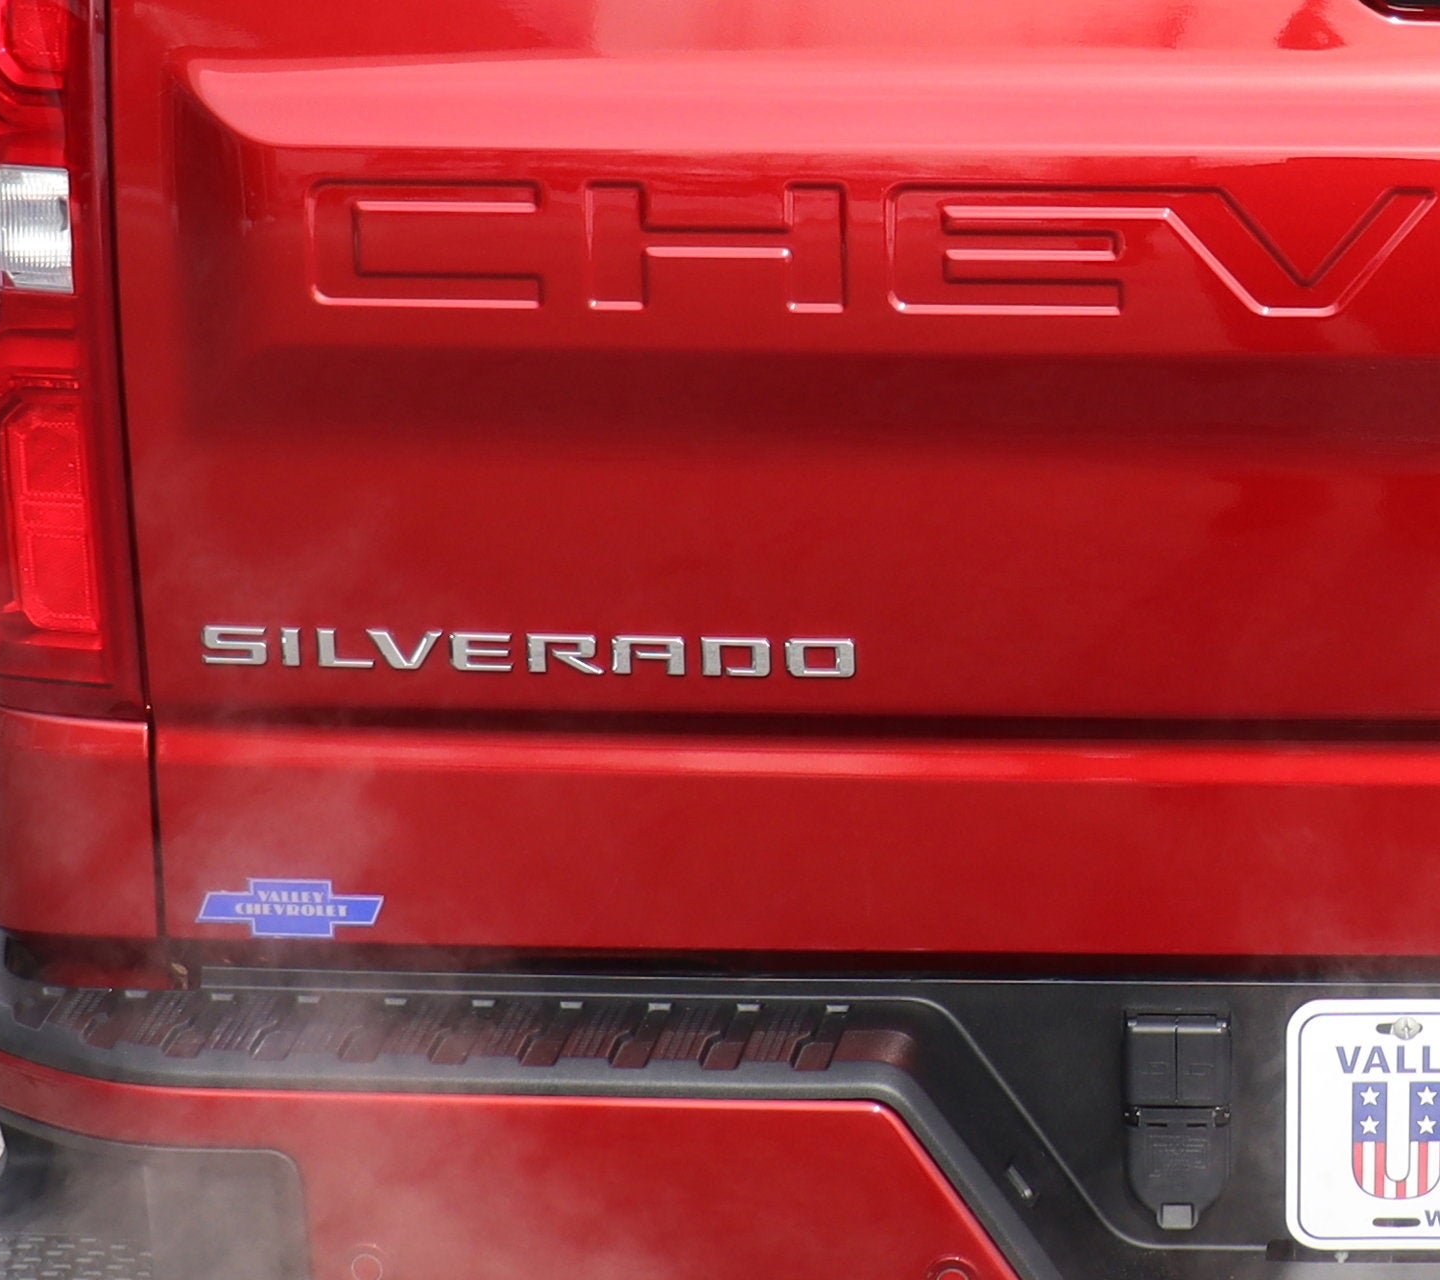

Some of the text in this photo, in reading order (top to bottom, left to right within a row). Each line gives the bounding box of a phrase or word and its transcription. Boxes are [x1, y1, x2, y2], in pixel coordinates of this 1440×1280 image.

[200, 624, 858, 678] SILVERADO
[257, 890, 326, 904] VALLEY
[234, 902, 349, 918] CHEVROLET
